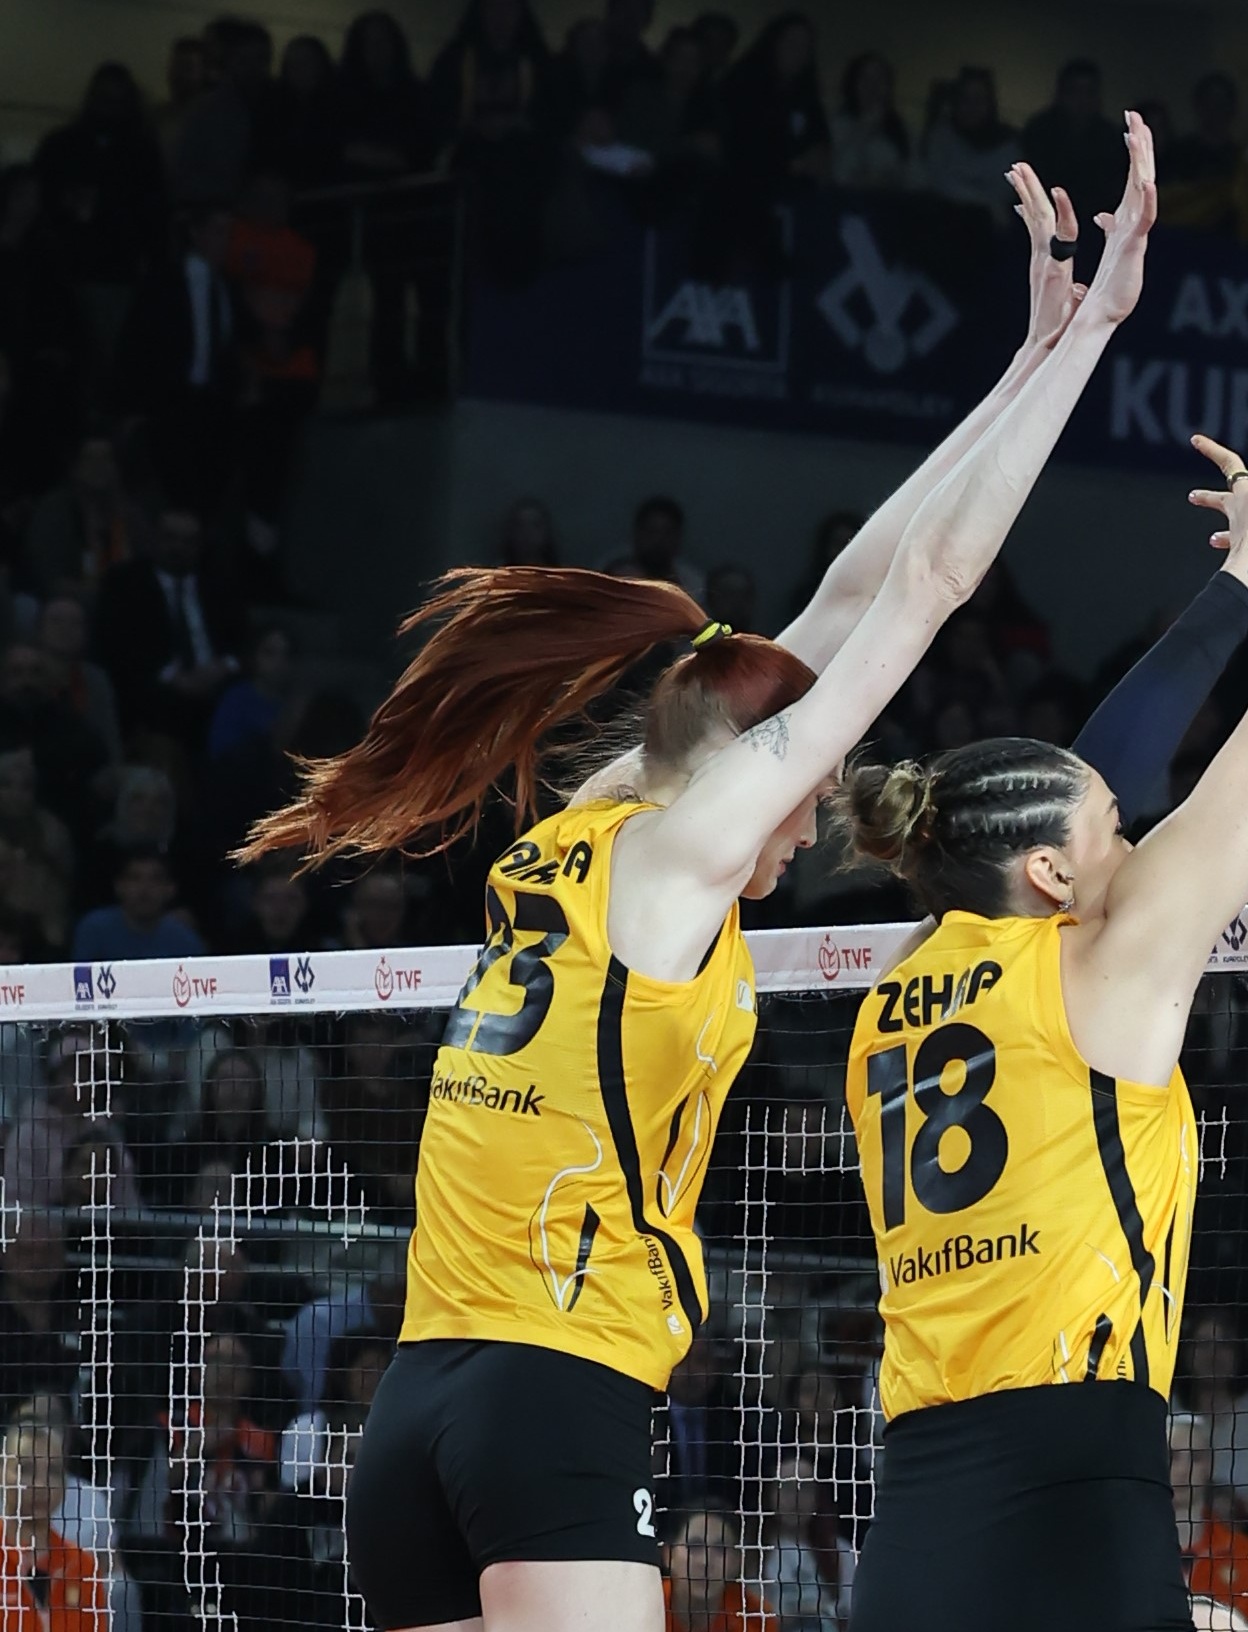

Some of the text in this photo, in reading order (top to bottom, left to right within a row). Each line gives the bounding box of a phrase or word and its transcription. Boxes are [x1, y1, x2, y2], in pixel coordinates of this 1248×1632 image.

[841, 948, 872, 970] TVF
[192, 978, 217, 998] TVF
[395, 970, 422, 991] TVF
[1, 985, 25, 1005] TVF
[866, 1022, 1009, 1233] 18
